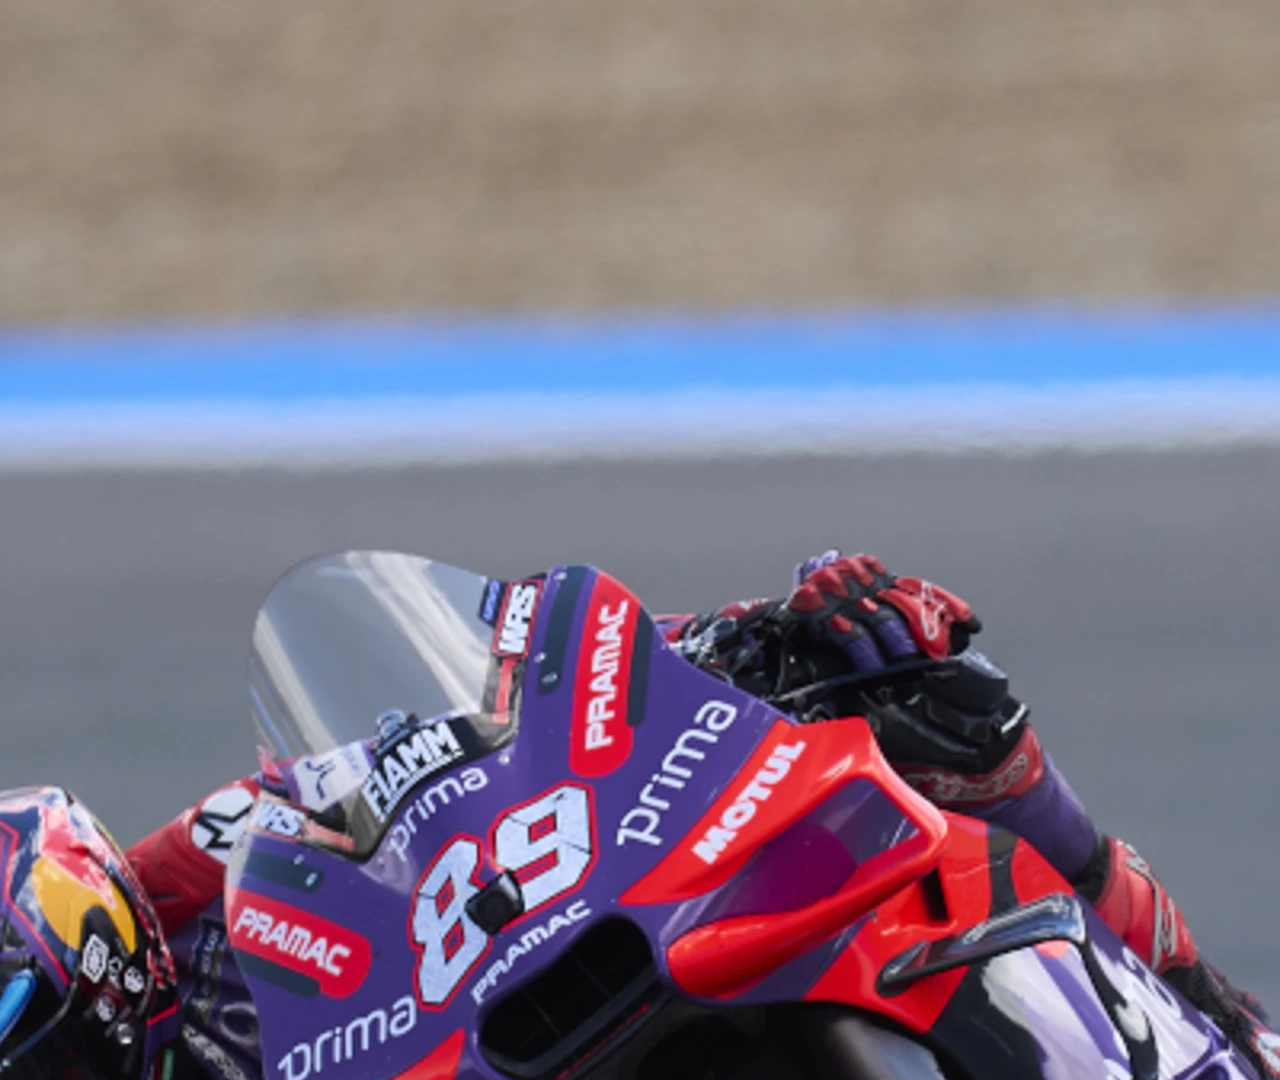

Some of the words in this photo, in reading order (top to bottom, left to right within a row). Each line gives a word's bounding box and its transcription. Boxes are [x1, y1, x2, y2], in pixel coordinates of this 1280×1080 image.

[585, 599, 629, 750] PRAMAC
[360, 721, 461, 823] FIAMM
[386, 766, 488, 863] prima
[617, 700, 738, 847] prima
[691, 739, 806, 865] MOTUL
[233, 905, 353, 977] PRAMAC
[410, 783, 595, 1008] 89
[470, 898, 592, 1003] PRAMAC
